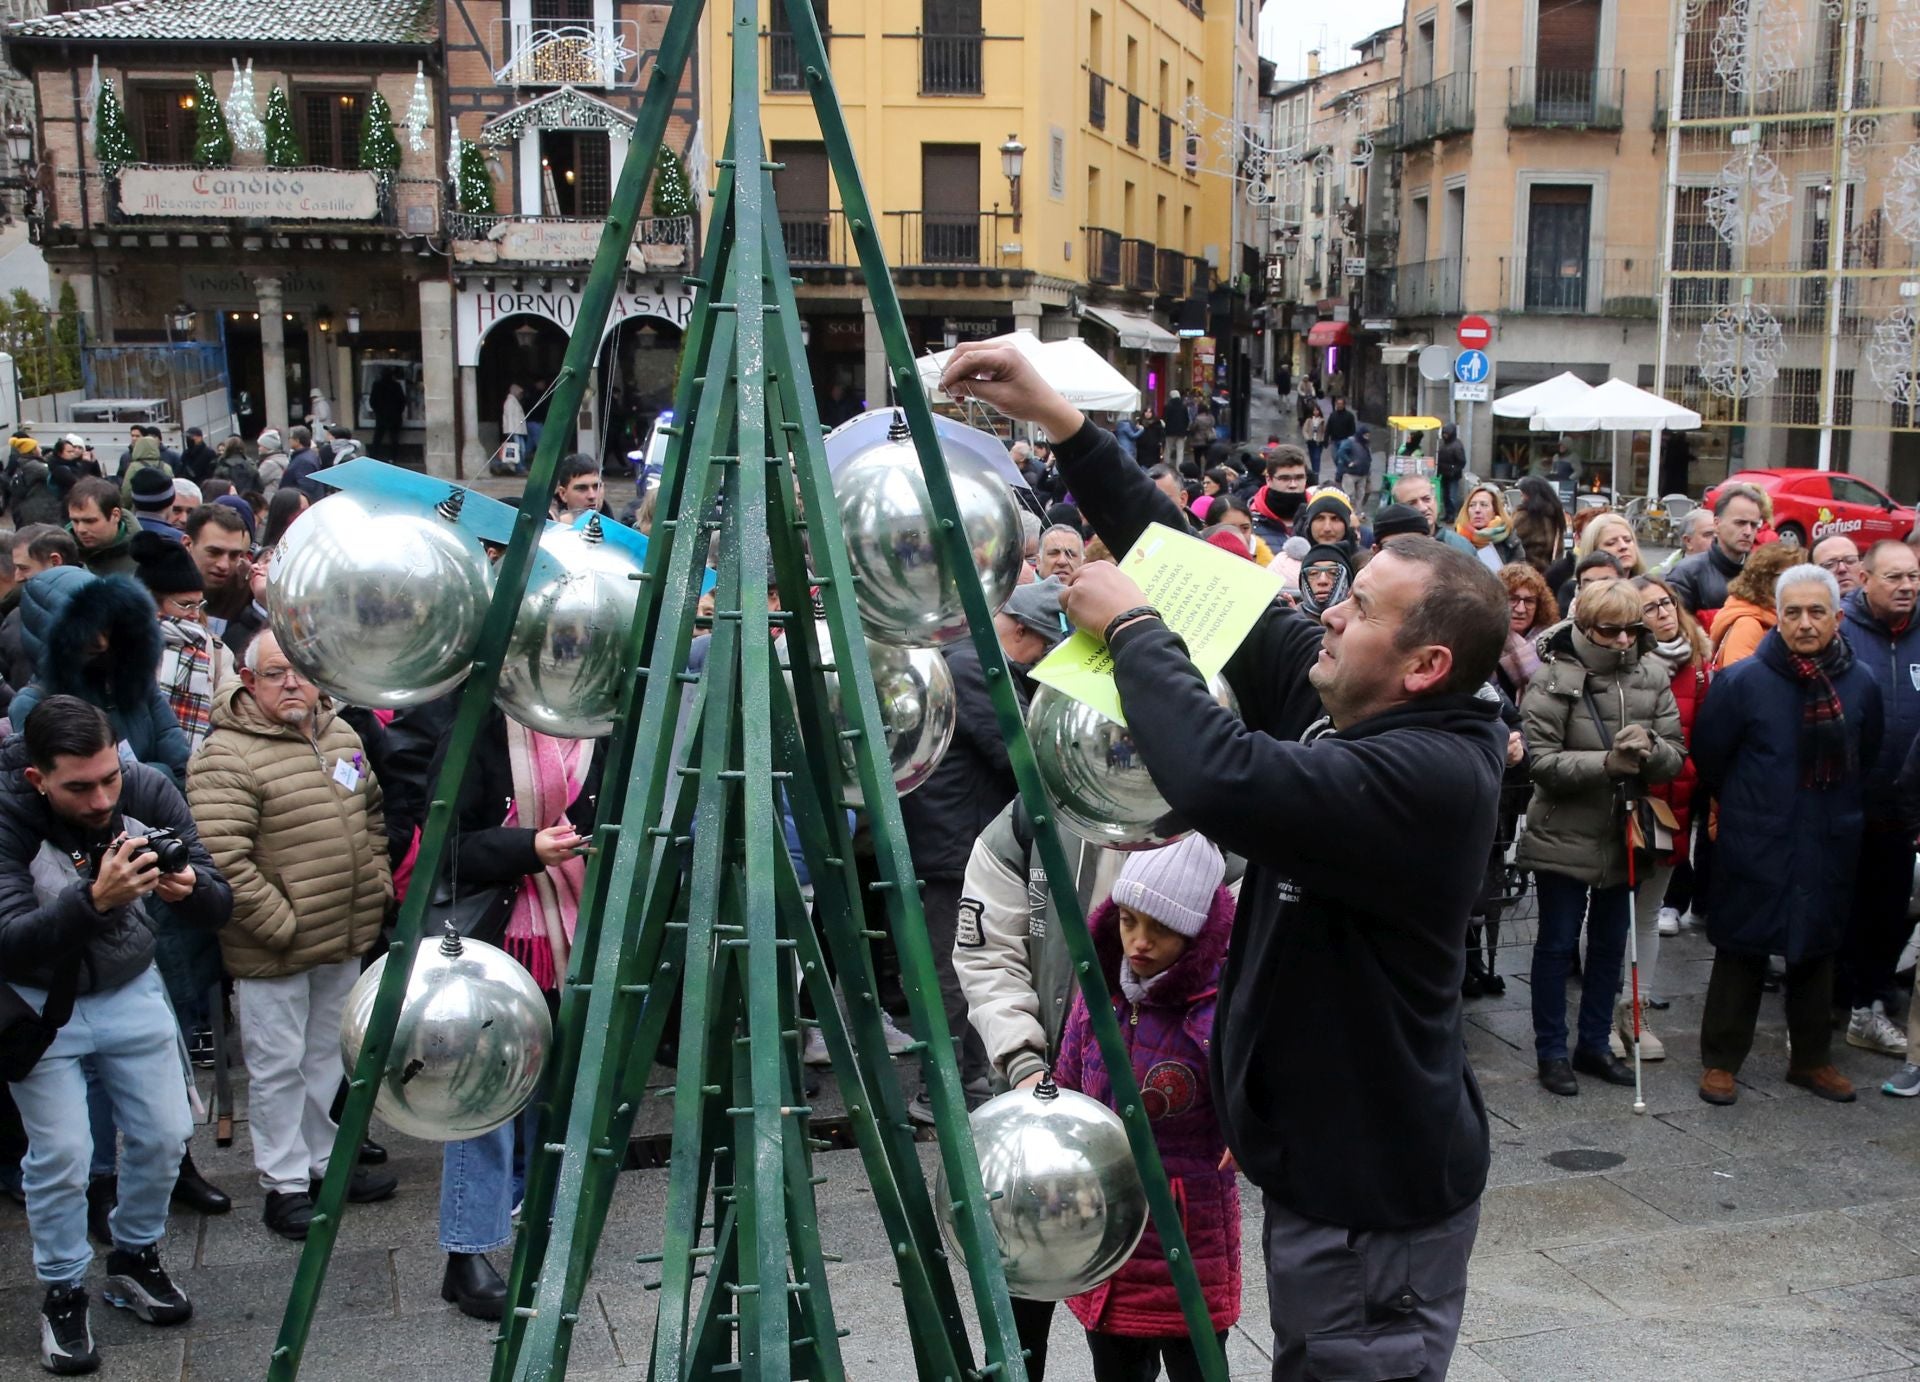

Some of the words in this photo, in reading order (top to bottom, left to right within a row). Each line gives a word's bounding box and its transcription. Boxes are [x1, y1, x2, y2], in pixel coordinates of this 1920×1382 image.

[561, 105, 609, 127] CANDID
[221, 196, 270, 213] Mayor
[476, 293, 575, 336] HORNO
[613, 295, 694, 325] ASAR
[1812, 518, 1862, 539] Grefusa
[1152, 563, 1184, 607] UIDADORAS
[1167, 593, 1193, 630] OPORTAN
